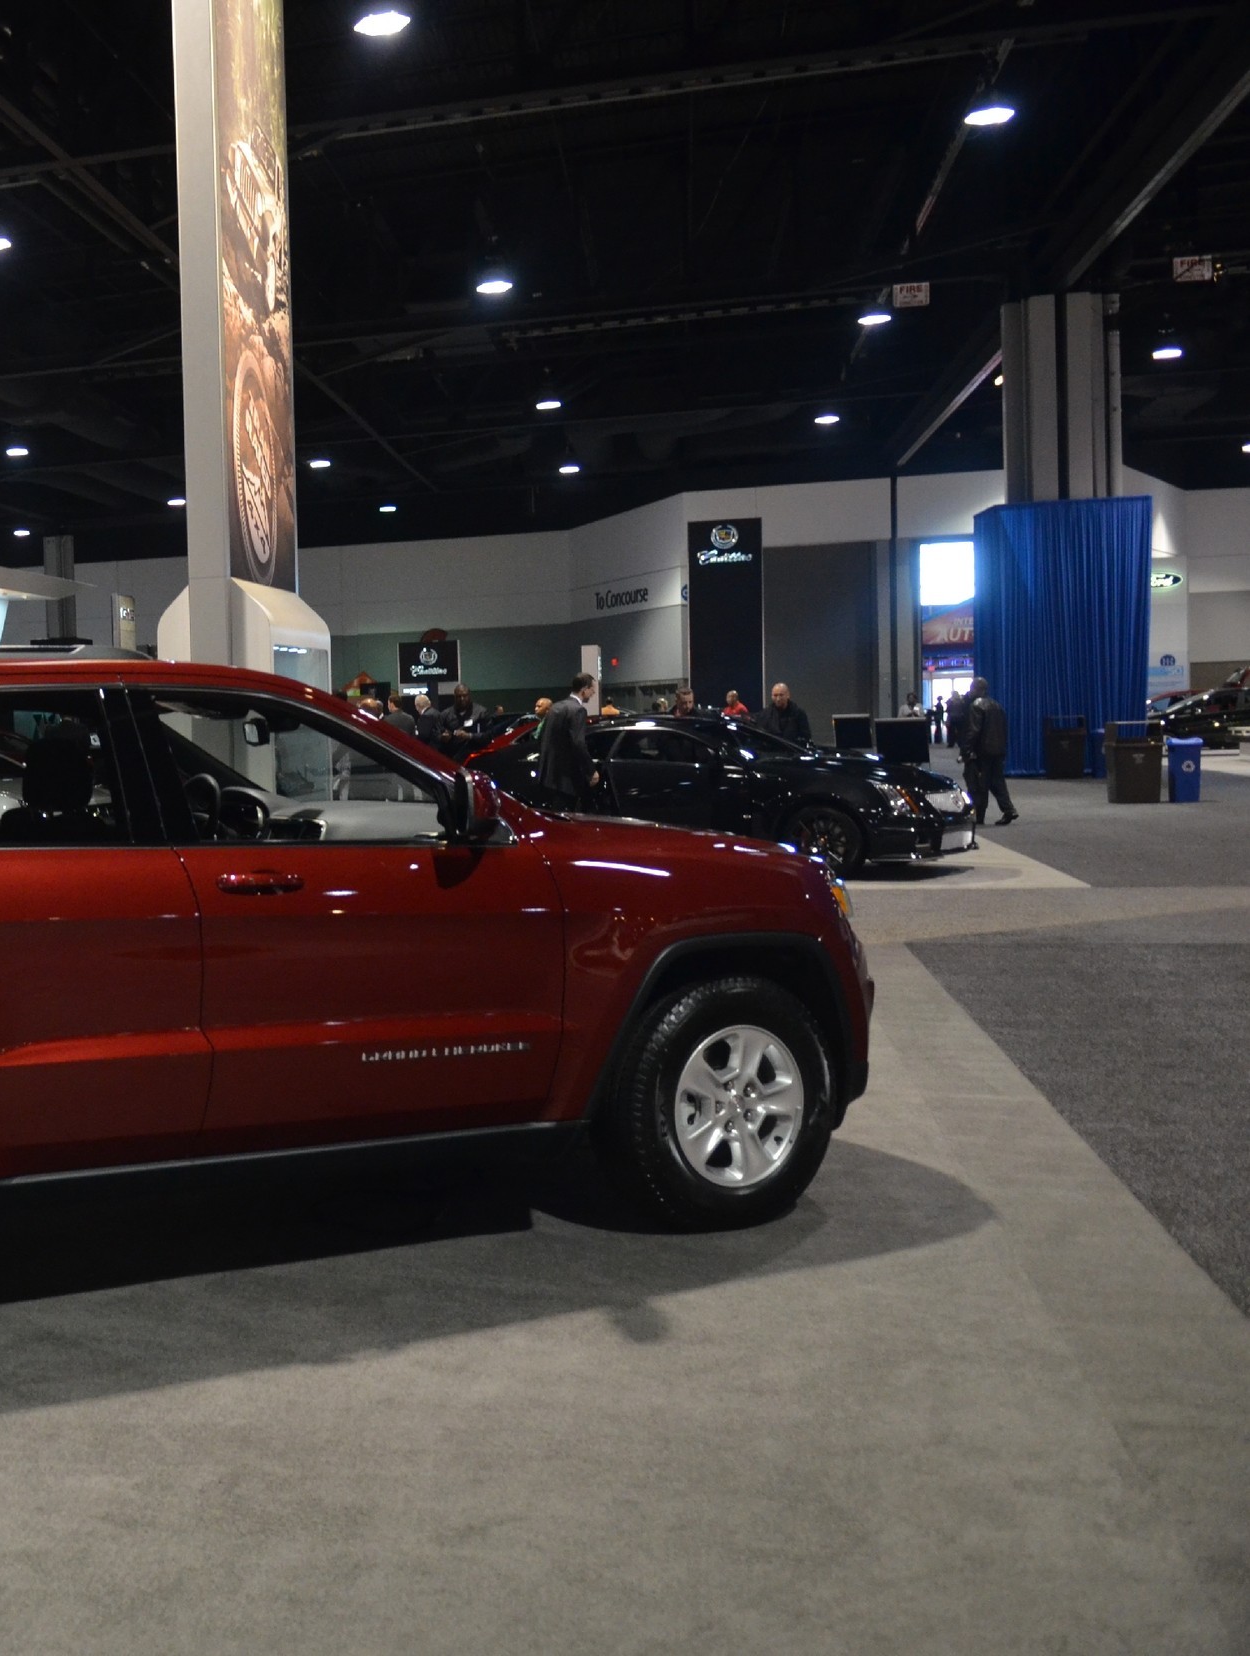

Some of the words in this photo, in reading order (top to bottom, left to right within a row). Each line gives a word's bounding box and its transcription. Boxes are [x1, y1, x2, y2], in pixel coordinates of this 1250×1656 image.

[899, 284, 923, 295] FIRE
[696, 549, 753, 566] Cadillac
[594, 592, 605, 610] To
[605, 587, 649, 609] Concourse
[934, 625, 974, 643] AUT
